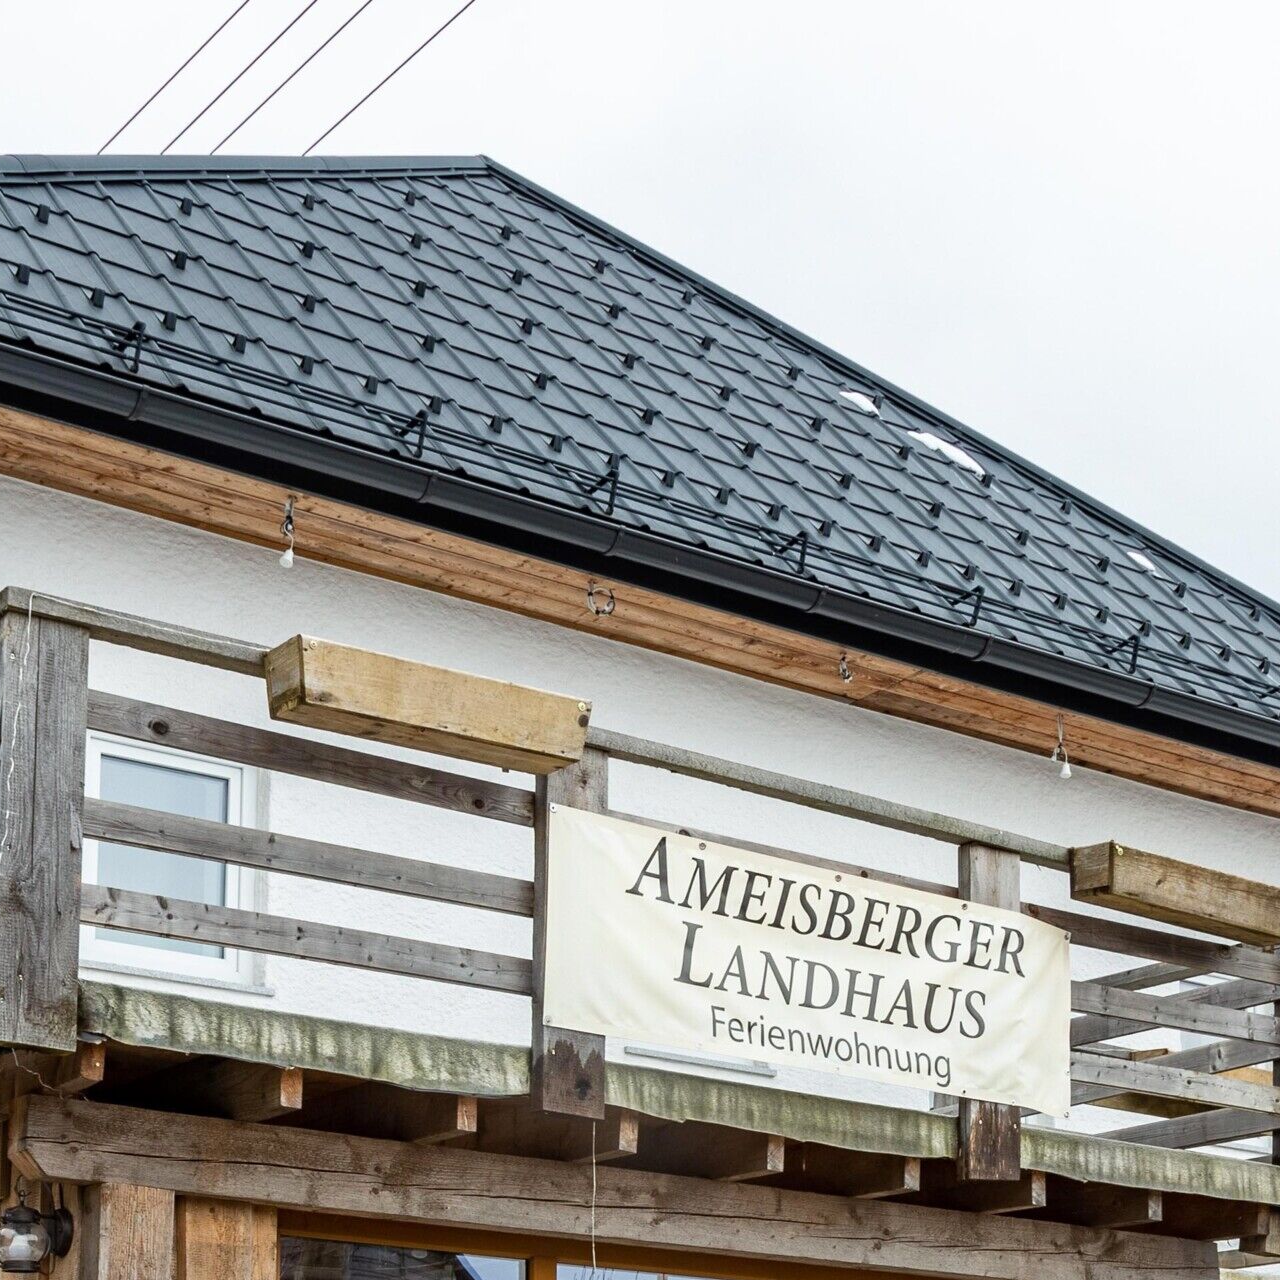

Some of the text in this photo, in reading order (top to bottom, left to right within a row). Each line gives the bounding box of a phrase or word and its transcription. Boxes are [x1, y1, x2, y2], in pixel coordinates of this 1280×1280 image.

[626, 836, 1025, 978] AMEISBERGER
[673, 921, 986, 1038] LANDHAUS
[711, 1005, 952, 1087] Ferienwohnung
